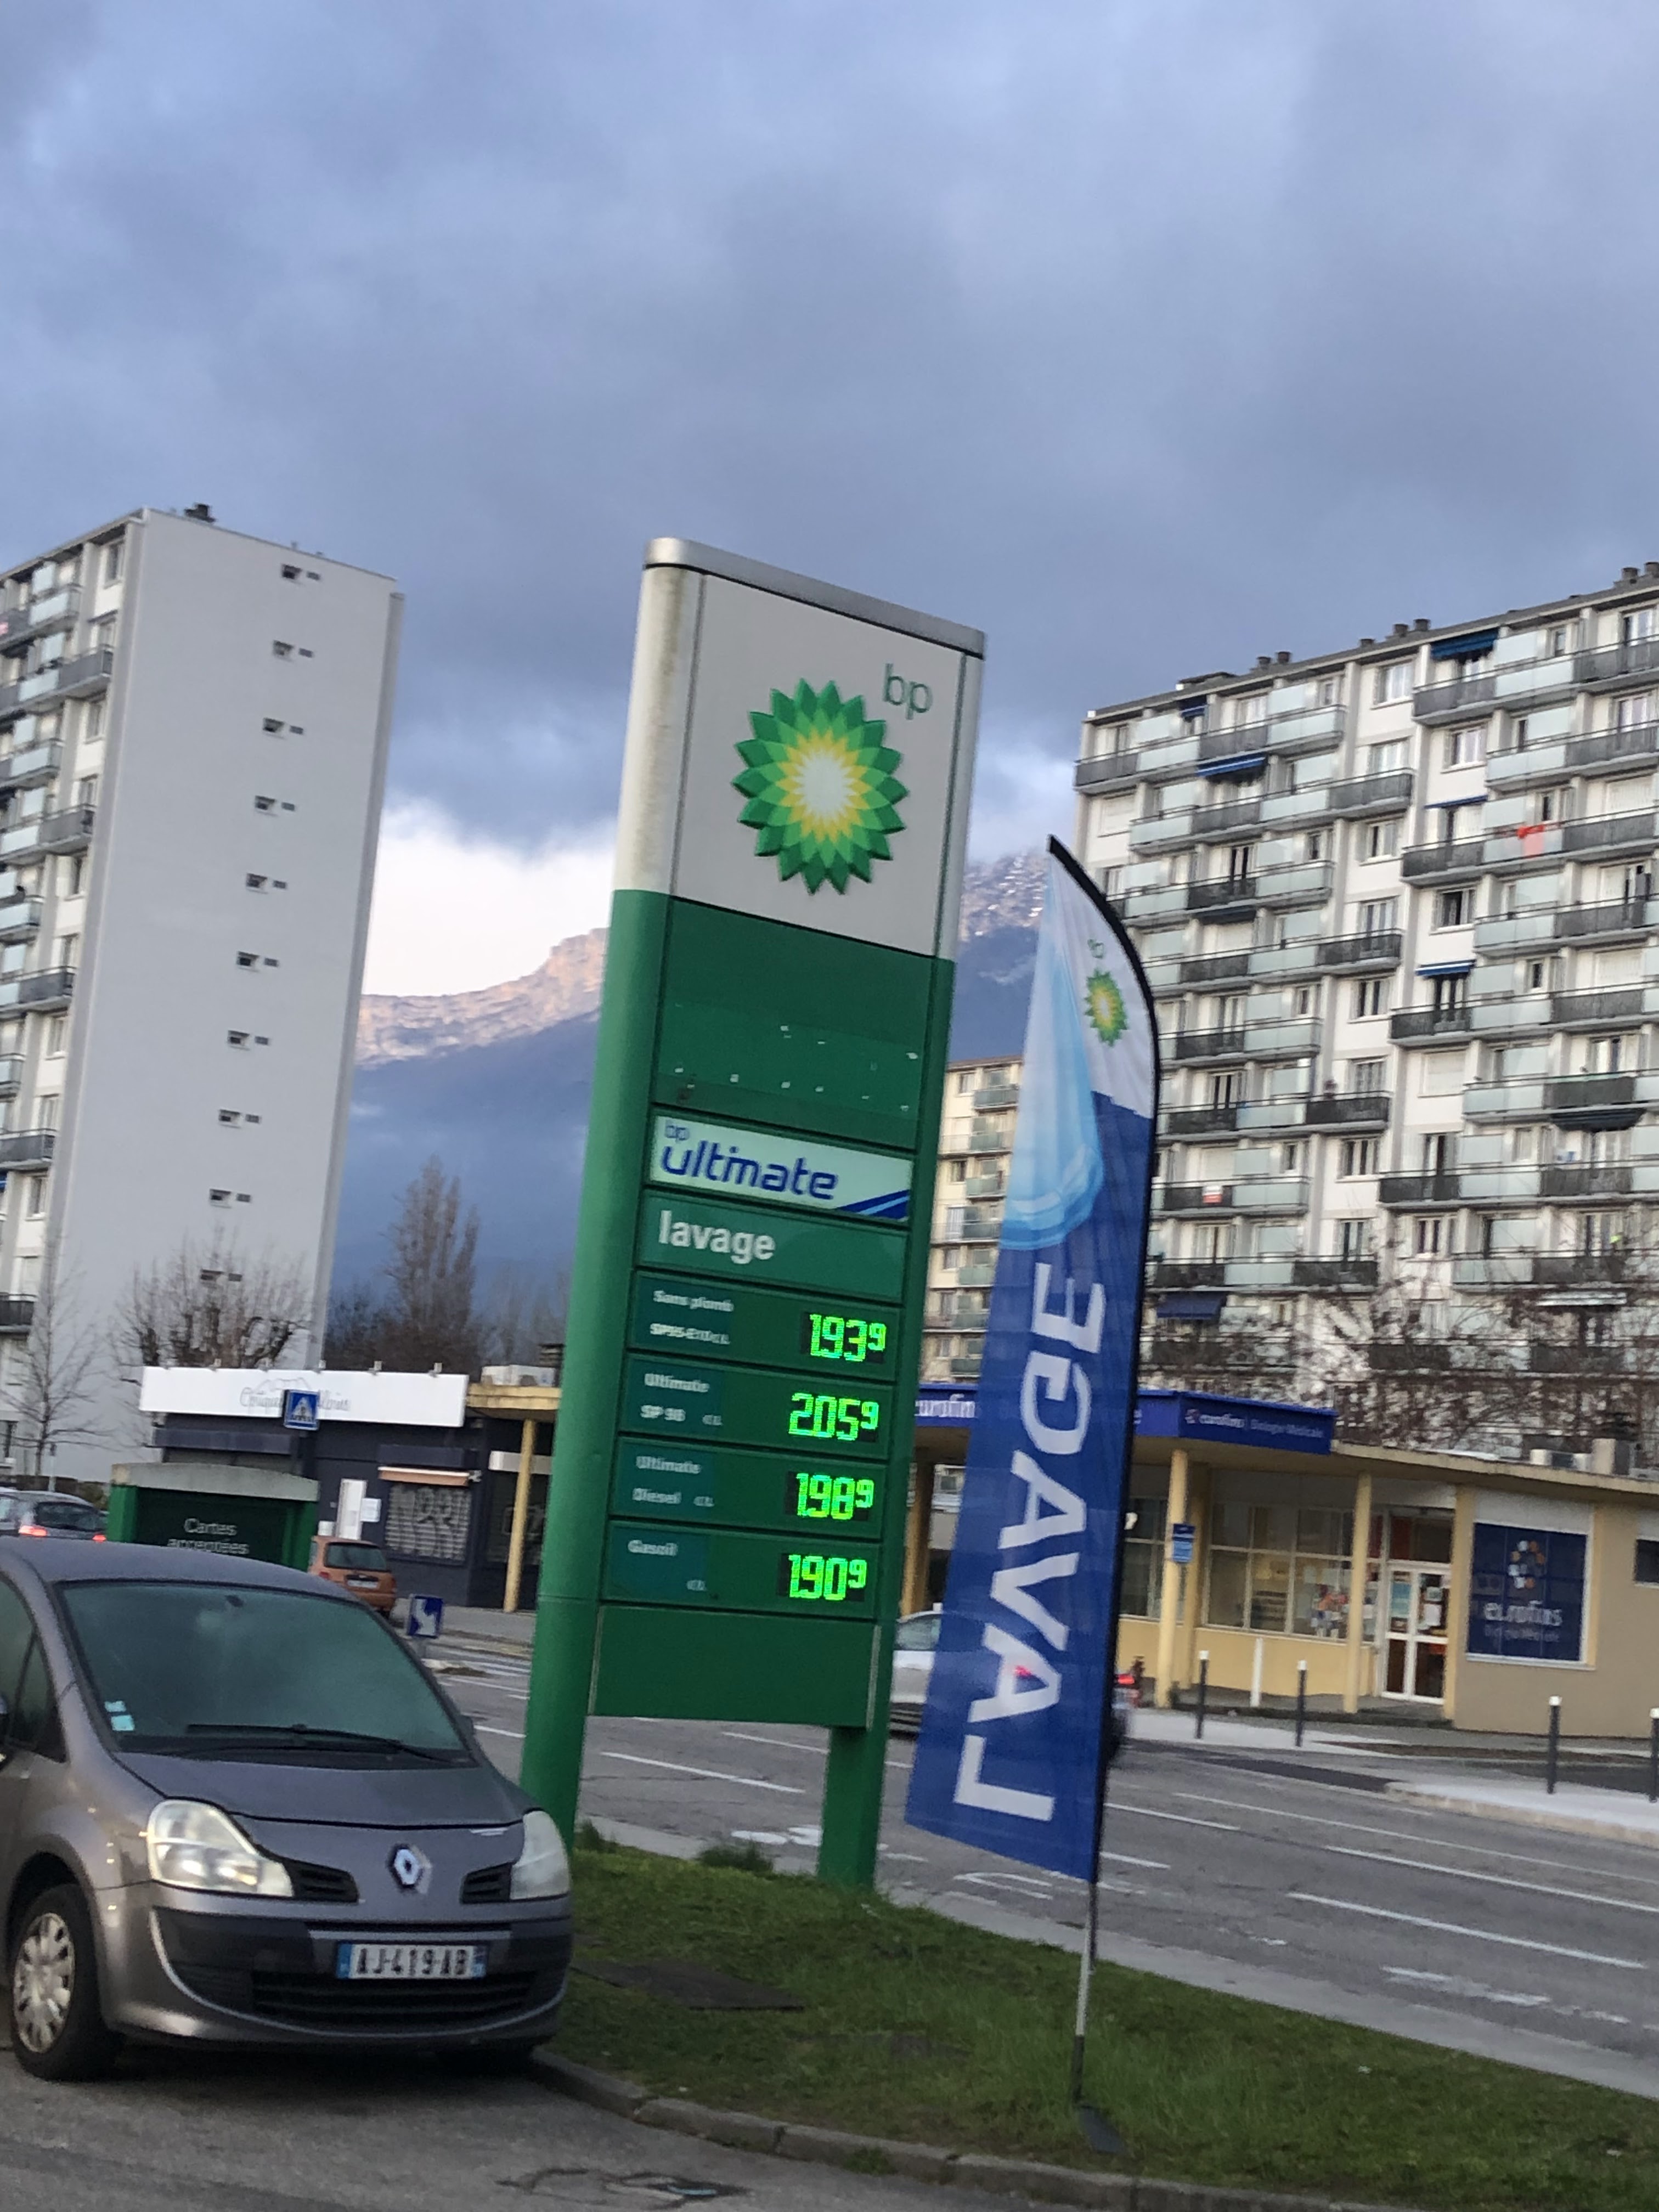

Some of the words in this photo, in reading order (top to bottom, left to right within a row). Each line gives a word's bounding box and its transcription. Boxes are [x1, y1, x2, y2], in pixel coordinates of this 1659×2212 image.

[883, 663, 934, 719] bp
[665, 1122, 689, 1143] bp
[660, 1140, 839, 1200] ultimate
[658, 1210, 776, 1264] lavage
[644, 1373, 710, 1393] Ultimate
[636, 1455, 702, 1475] Ultimate
